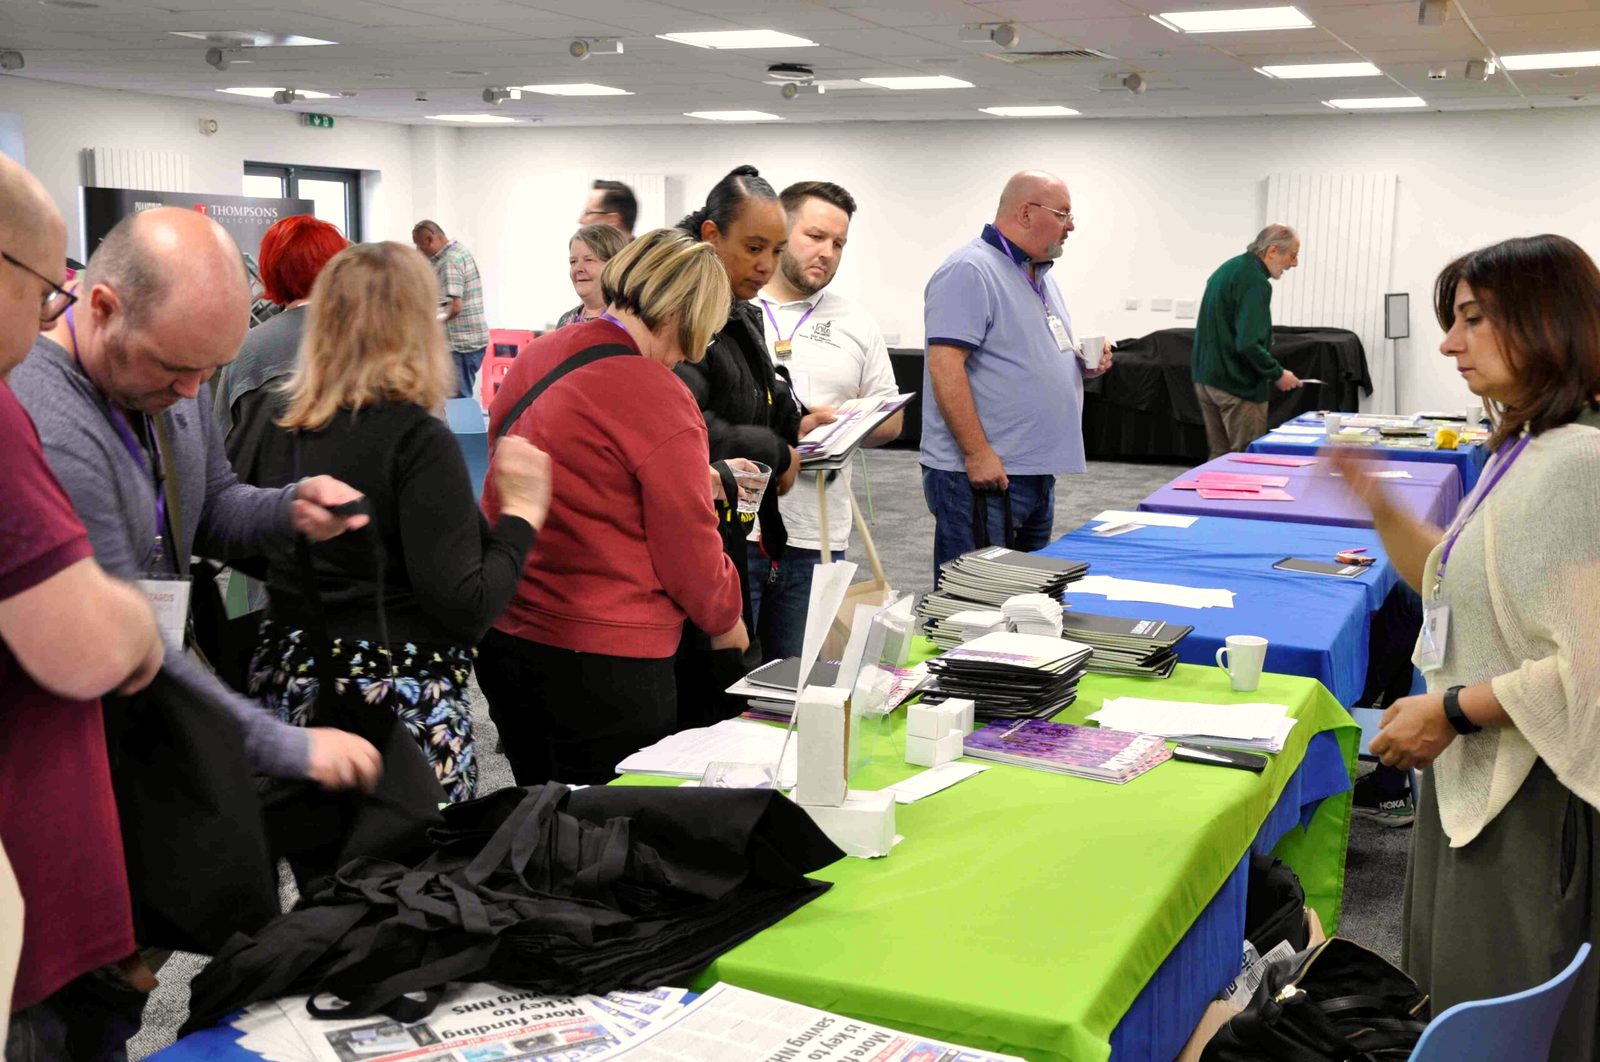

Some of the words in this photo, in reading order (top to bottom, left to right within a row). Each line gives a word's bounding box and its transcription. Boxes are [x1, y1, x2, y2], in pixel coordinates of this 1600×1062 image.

[211, 205, 278, 217] THOMPSONS
[1379, 799, 1406, 810] HOKA
[498, 991, 545, 1004] ving
[451, 1000, 495, 1015] NHS
[518, 999, 556, 1011] key
[492, 1007, 516, 1017] to
[532, 1008, 586, 1021] More
[441, 1018, 530, 1039] funding
[786, 1016, 836, 1048] saving
[844, 1023, 867, 1035] is
[819, 1031, 856, 1051] key
[849, 1031, 892, 1058] More
[764, 1045, 797, 1062] NH
[807, 1047, 833, 1061] to
